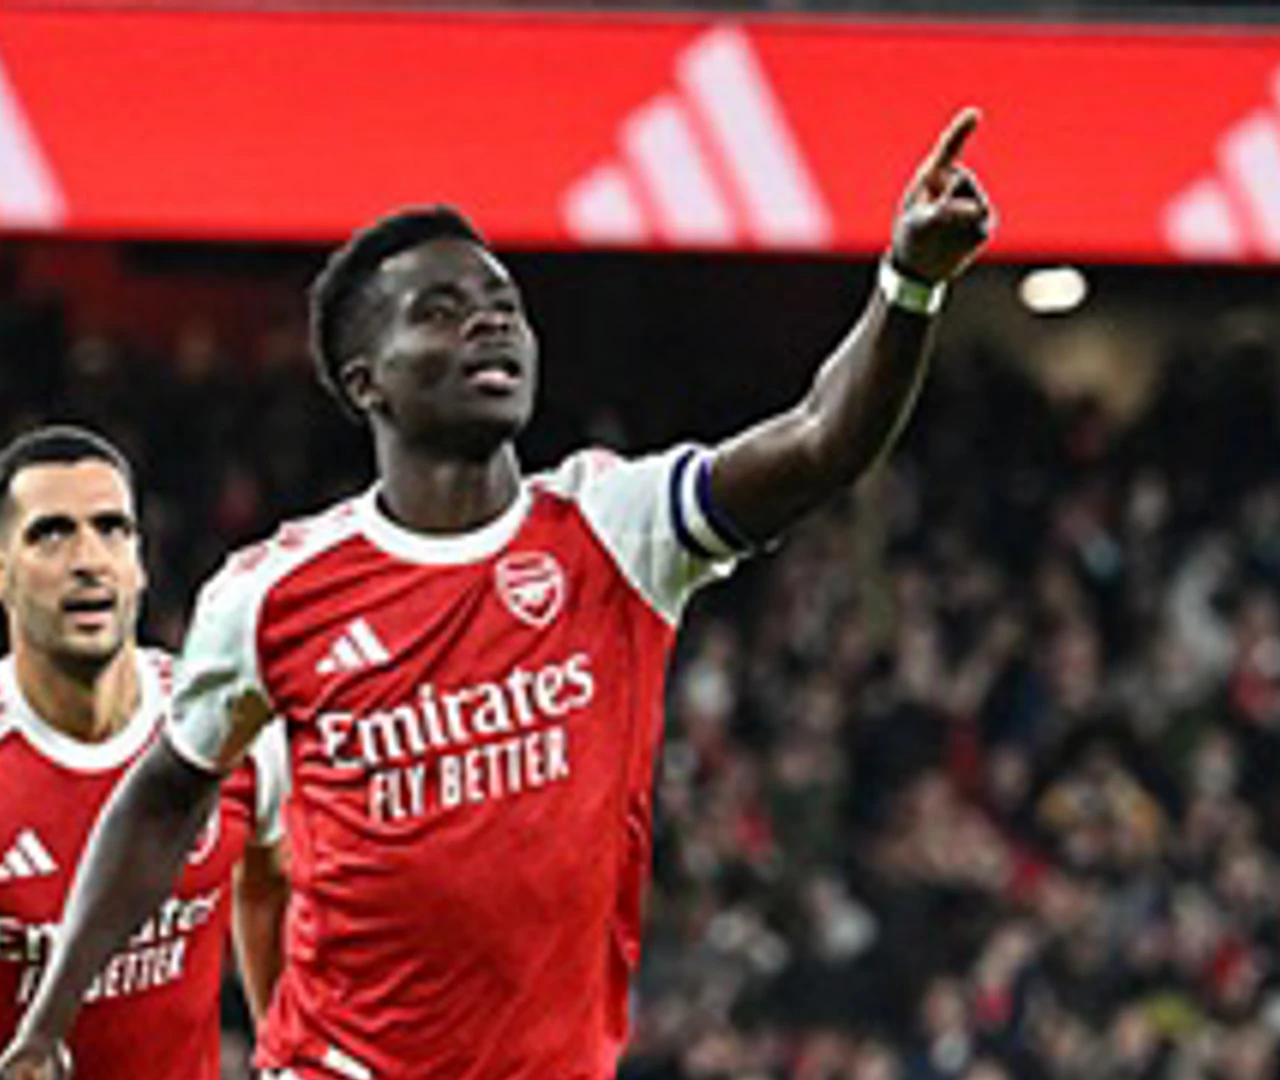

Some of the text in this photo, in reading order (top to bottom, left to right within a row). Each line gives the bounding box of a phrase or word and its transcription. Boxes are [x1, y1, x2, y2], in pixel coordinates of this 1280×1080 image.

[317, 653, 595, 769] Emirates
[369, 727, 569, 823] FLY BETTER
